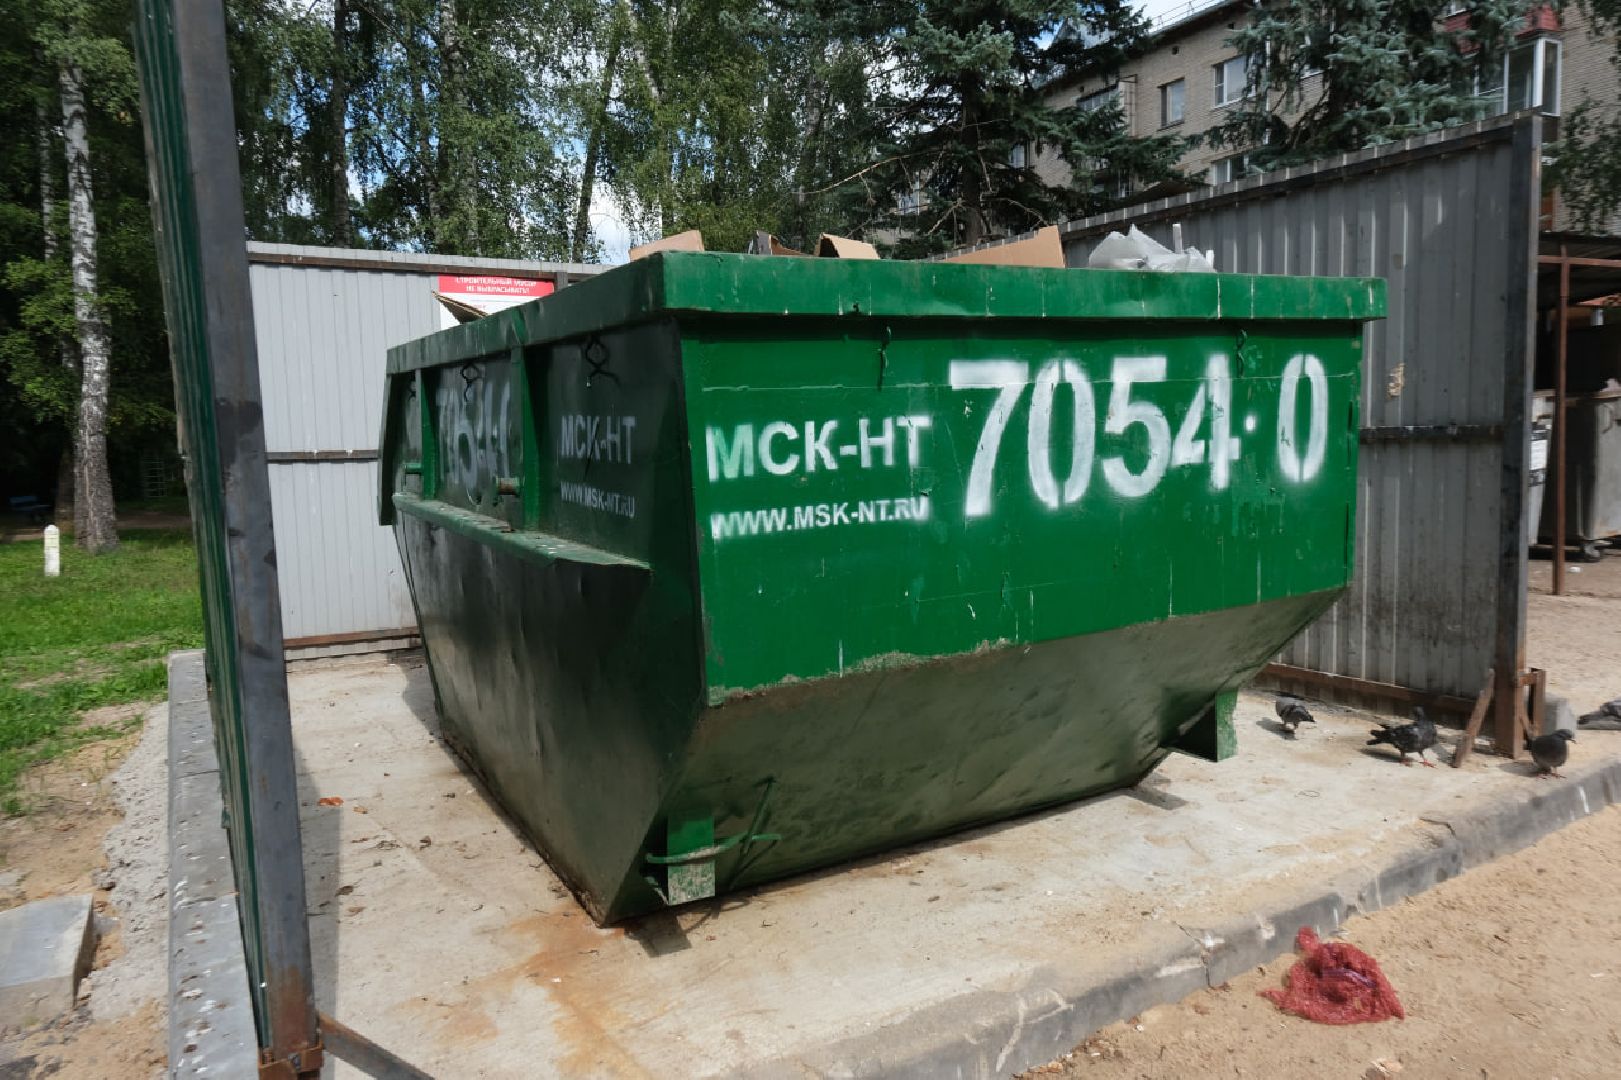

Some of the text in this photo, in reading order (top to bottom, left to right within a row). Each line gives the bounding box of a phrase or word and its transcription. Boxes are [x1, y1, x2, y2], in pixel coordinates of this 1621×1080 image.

[561, 415, 636, 465] МСК-НТ
[705, 415, 933, 482] МСК-НТ
[710, 495, 930, 540] WWW.MSK-NT.RU
